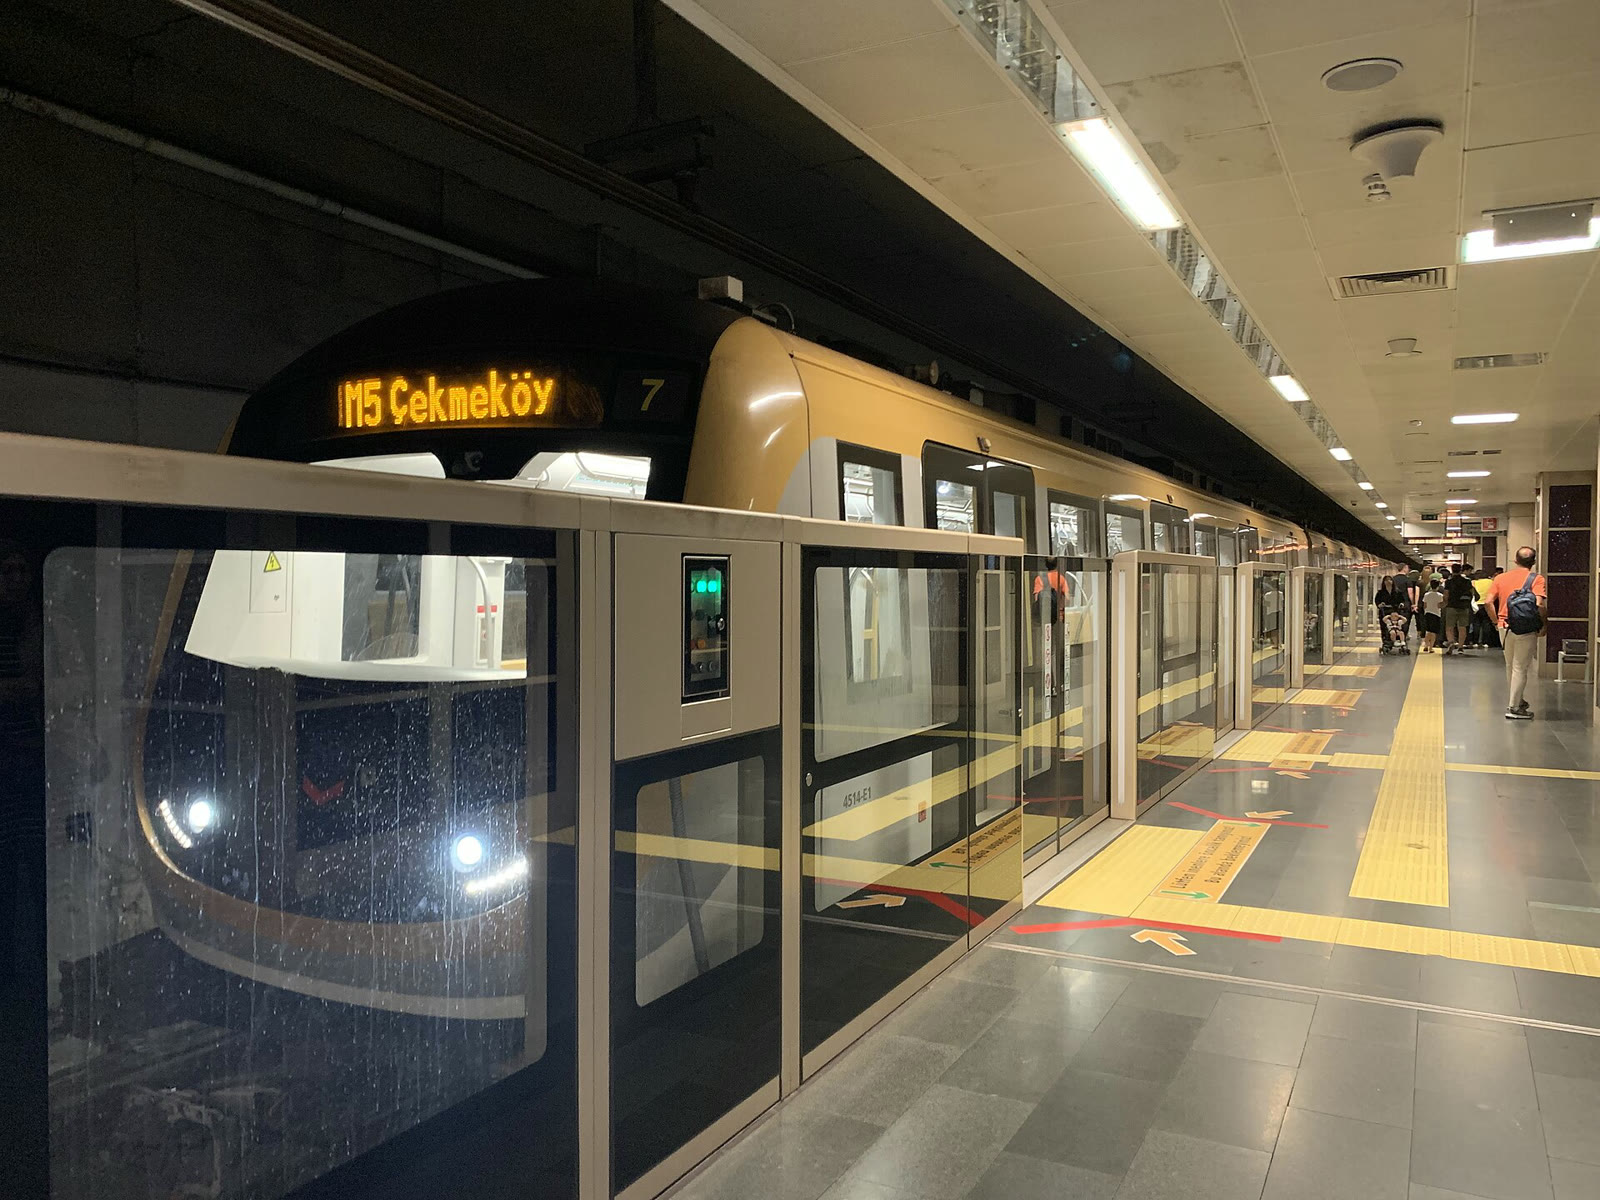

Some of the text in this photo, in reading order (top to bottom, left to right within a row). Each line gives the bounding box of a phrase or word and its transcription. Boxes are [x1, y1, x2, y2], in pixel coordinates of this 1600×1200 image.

[344, 369, 554, 428] M5 Çekmeköy
[641, 378, 665, 412] 7
[842, 786, 872, 808] 4514-E1
